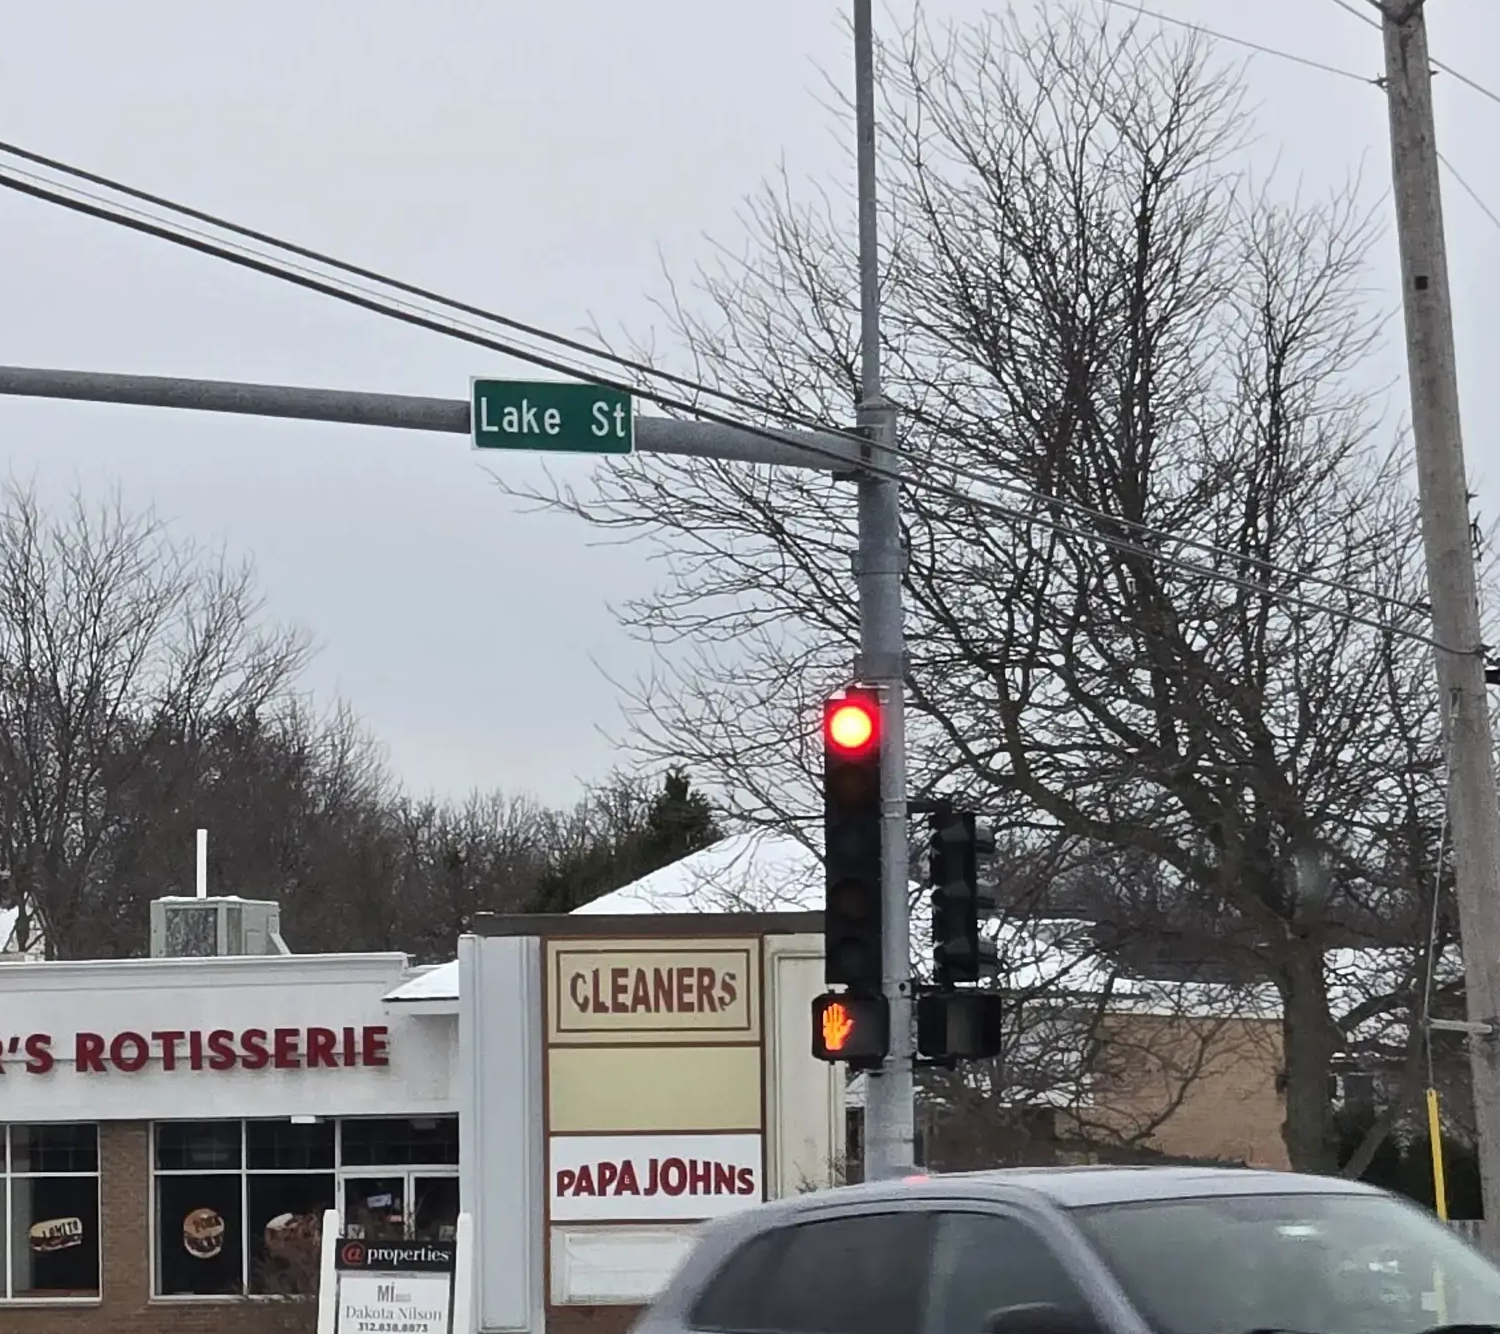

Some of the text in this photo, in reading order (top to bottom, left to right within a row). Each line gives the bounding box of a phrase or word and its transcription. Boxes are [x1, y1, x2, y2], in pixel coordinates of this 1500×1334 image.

[480, 396, 626, 437] Lake St
[570, 967, 737, 1013] CLEANERS
[75, 1026, 389, 1072] ROTISSERIE
[556, 1157, 755, 1197] PAPA JOHNS
[345, 1305, 442, 1321] Dakota Nilson
